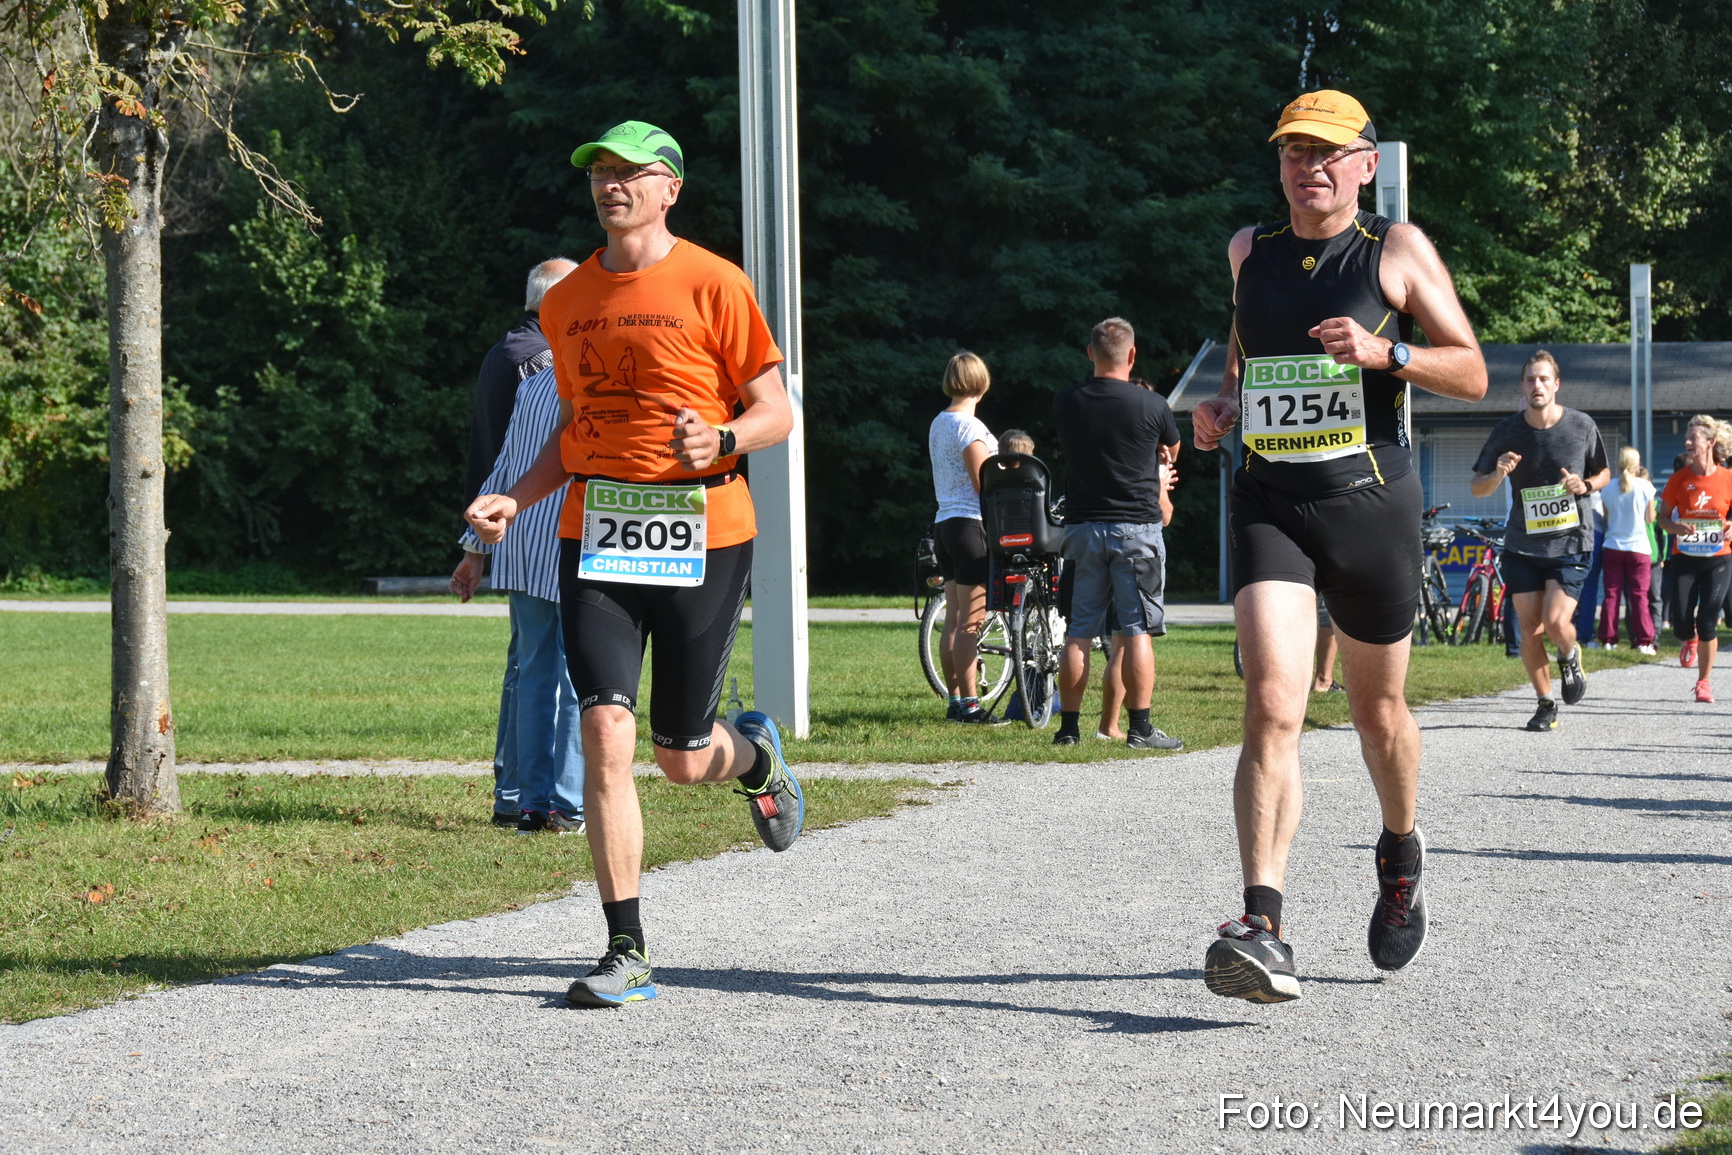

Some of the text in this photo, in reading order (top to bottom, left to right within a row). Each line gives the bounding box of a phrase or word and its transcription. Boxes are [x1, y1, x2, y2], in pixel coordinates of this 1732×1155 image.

[617, 317, 684, 329] DER NEUE TAG
[1252, 360, 1351, 385] BOCK
[1257, 392, 1350, 427] 1254
[1254, 432, 1353, 450] BERNHARD
[594, 485, 696, 511] BOCK
[1531, 499, 1570, 517] 1008
[1537, 517, 1567, 528] STEFAN
[597, 518, 692, 551] 2609
[1683, 532, 1718, 544] 2310
[592, 558, 693, 575] CHRISTIAN
